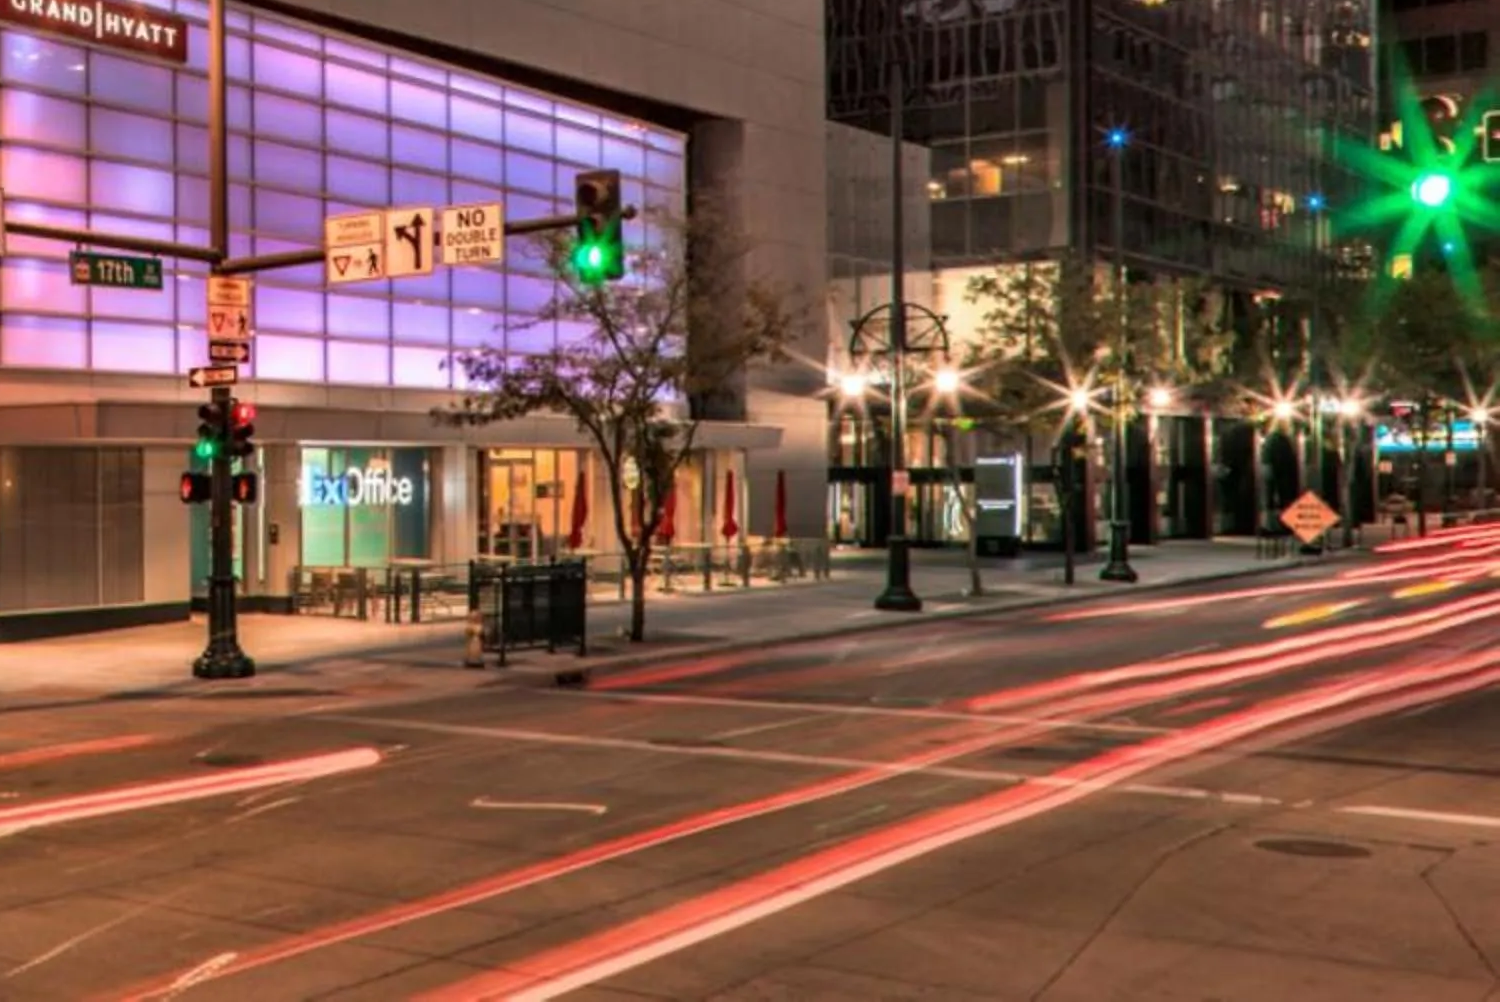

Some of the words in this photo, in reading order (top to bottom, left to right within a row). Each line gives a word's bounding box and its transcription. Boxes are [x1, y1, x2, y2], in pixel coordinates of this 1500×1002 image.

[105, 13, 177, 47] HYATT
[457, 209, 485, 228] NO
[446, 228, 497, 246] DOUBLE
[455, 246, 491, 262] TURN
[97, 259, 135, 284] 17th
[346, 466, 413, 507] Office
